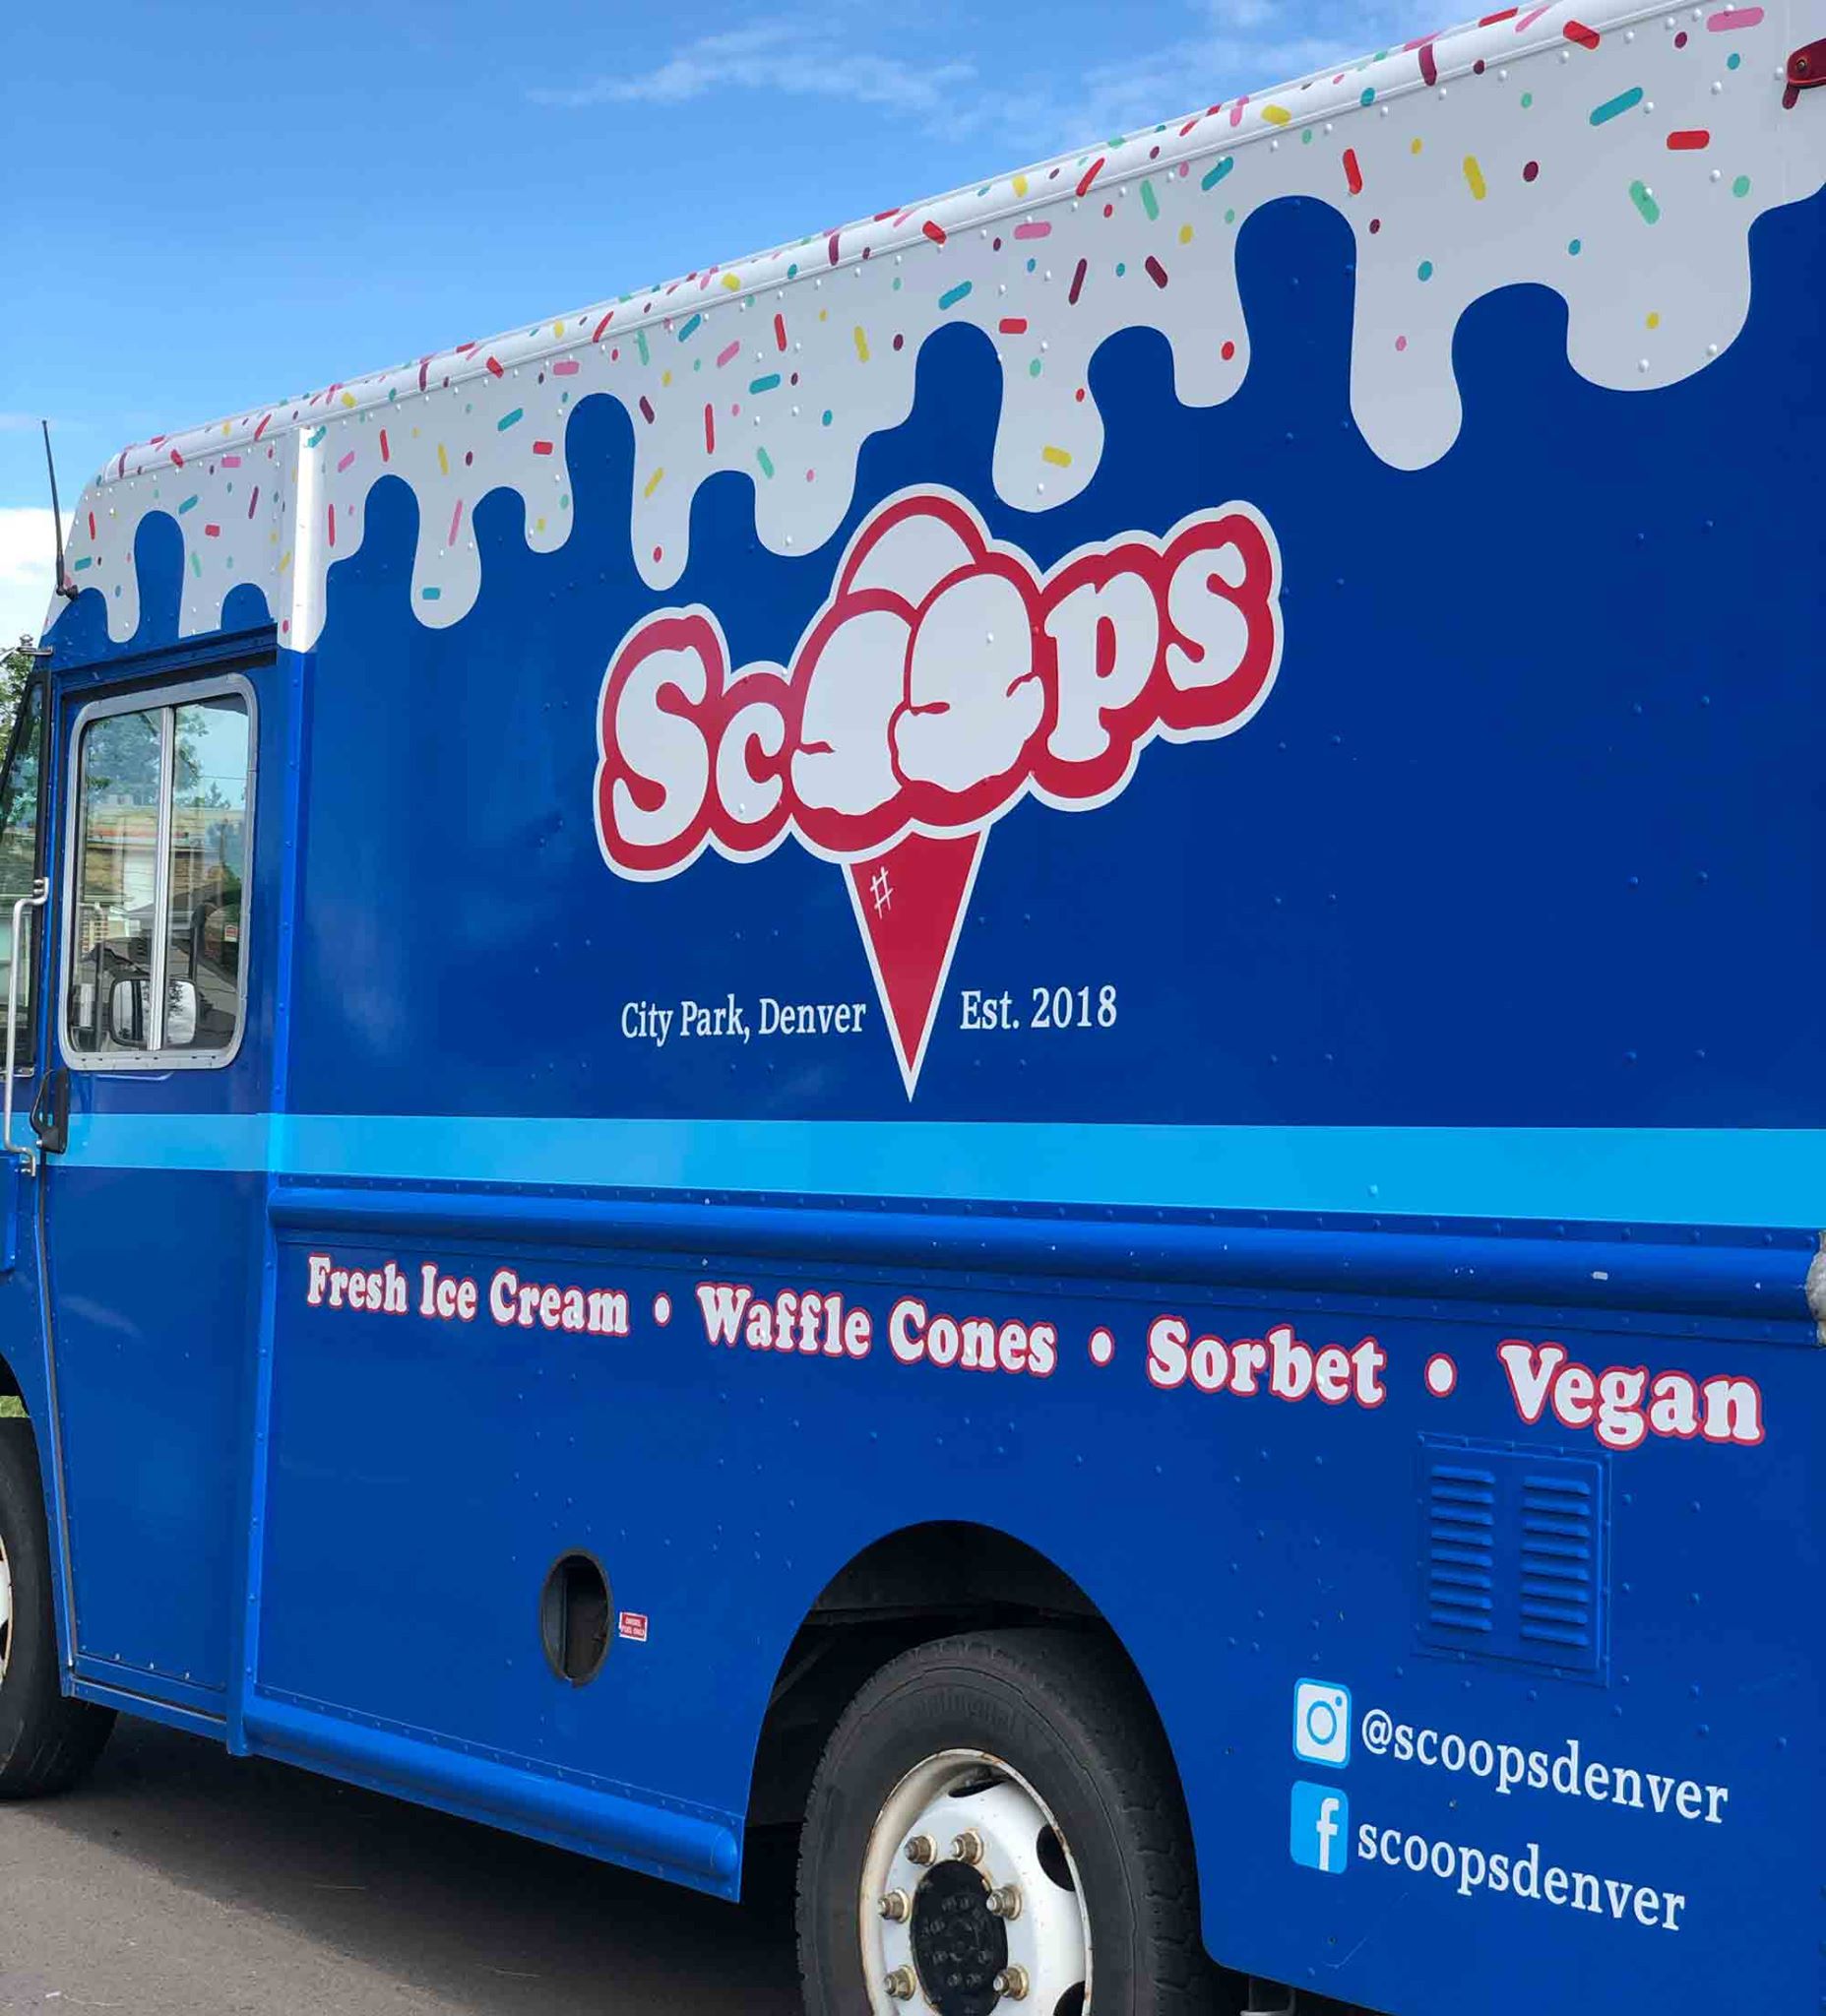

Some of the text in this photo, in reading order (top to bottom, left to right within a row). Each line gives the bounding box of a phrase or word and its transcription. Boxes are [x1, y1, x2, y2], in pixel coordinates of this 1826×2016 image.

[598, 504, 1276, 873] Scoops
[622, 994, 865, 1046] City Park, Denver
[960, 984, 1118, 1031] Est. 2018
[307, 1253, 629, 1337] Fresh Ice Cream
[696, 1283, 1057, 1377] Waffle Cones
[1147, 1314, 1387, 1408] Sorbet
[1497, 1340, 1765, 1450] Vegan
[1360, 1708, 1730, 1824] @scoopsdenver
[1356, 1822, 1686, 1931] scoopsdenver
